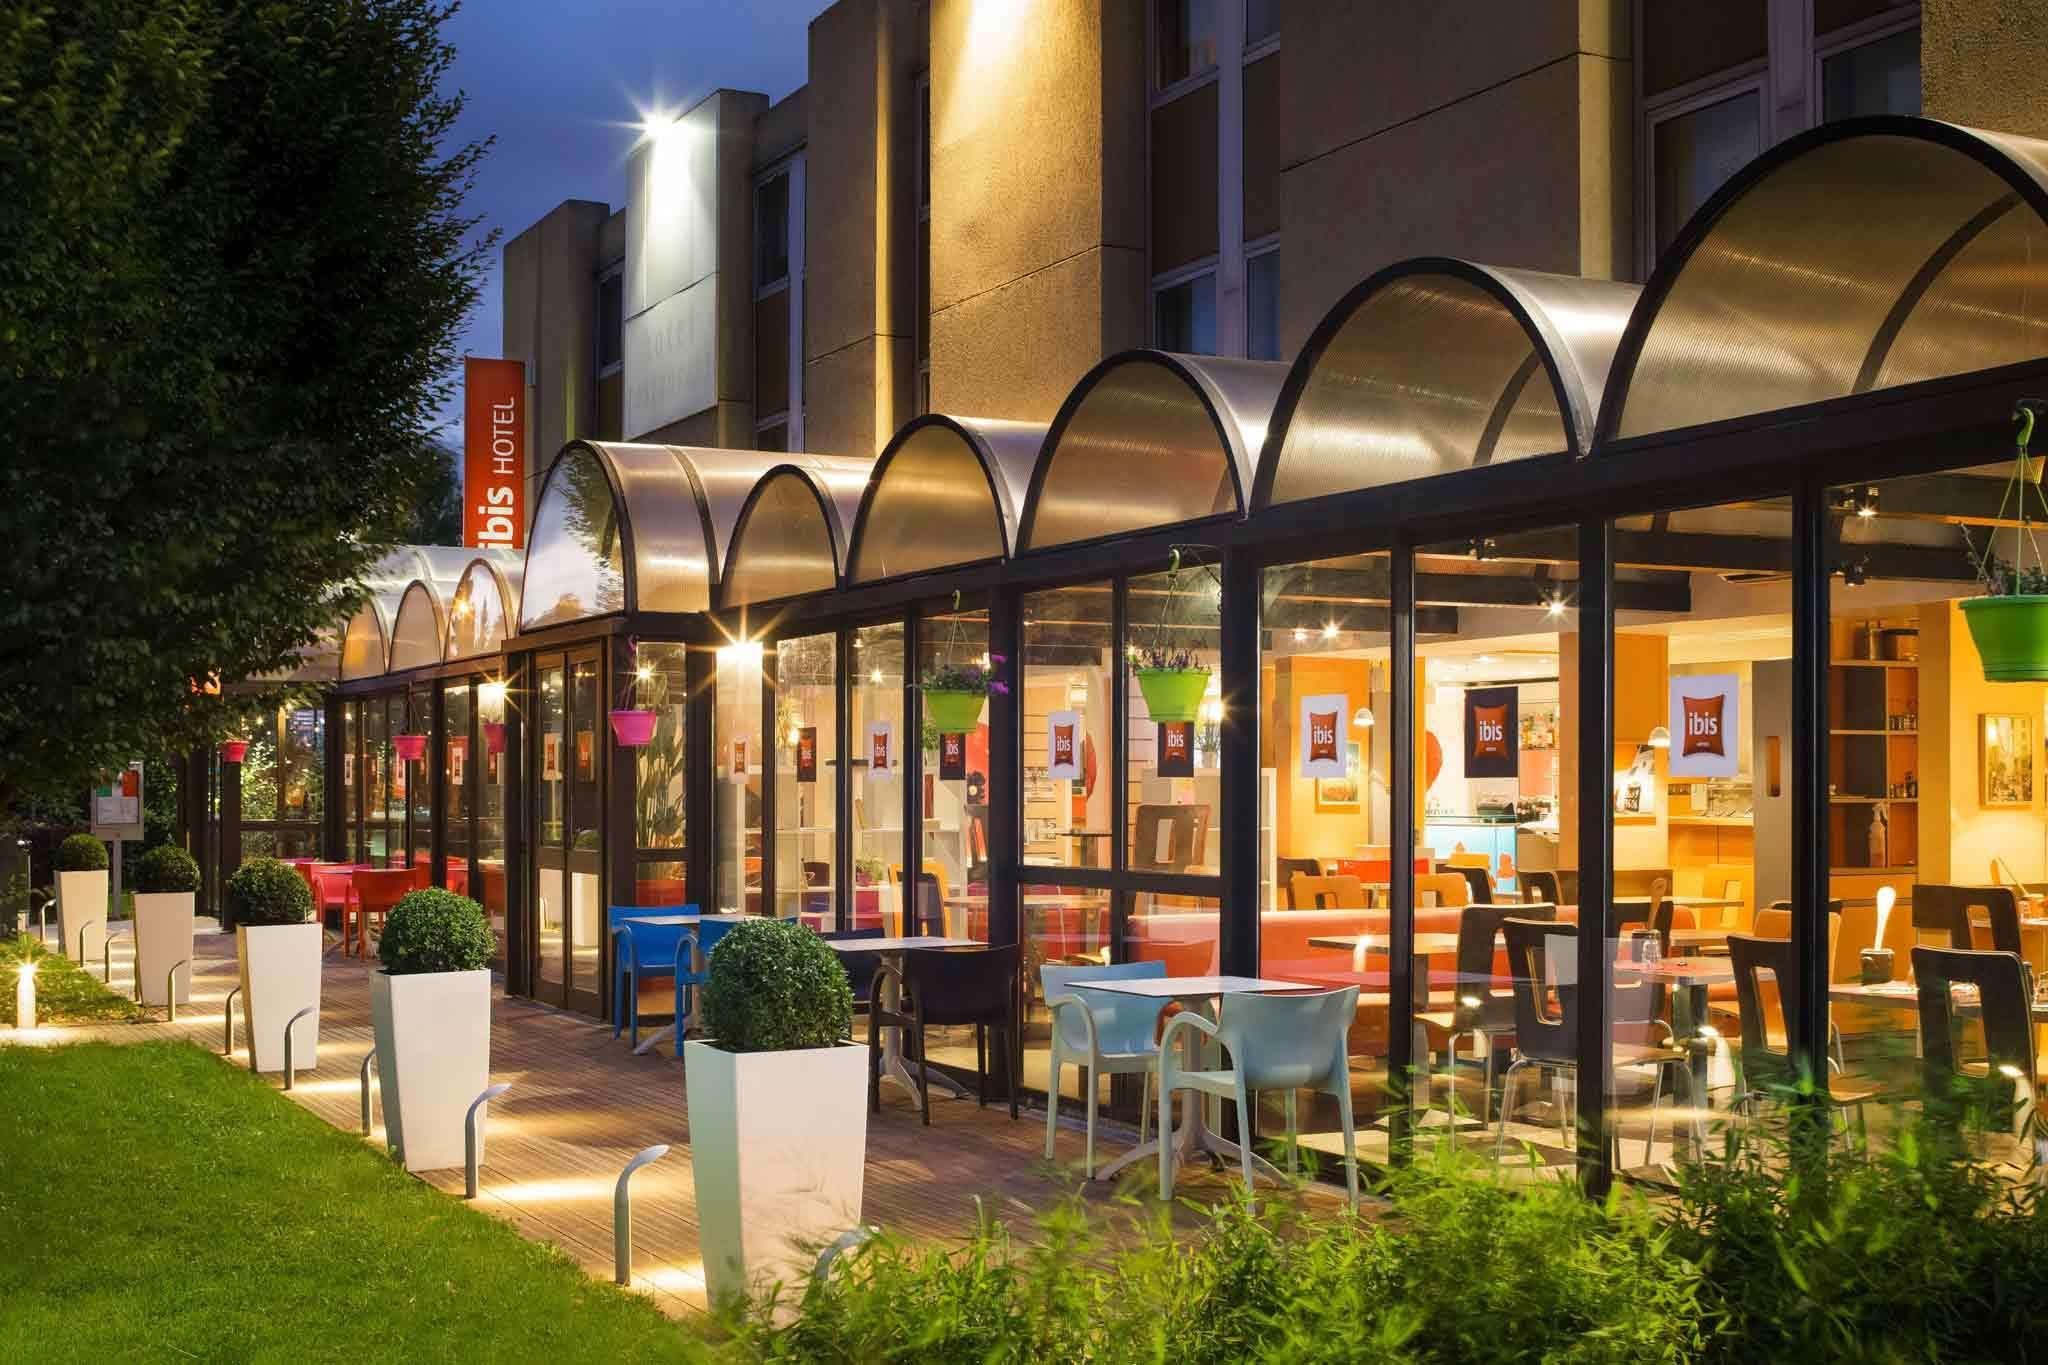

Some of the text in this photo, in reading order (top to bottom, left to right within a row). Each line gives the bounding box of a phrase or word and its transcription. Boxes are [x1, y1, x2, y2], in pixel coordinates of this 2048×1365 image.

[477, 396, 515, 549] ibis HOTEL
[1313, 723, 1334, 745] ibis
[1479, 719, 1503, 742] ibis
[1688, 711, 1718, 736] ibis
[1056, 735, 1072, 752] ibis
[1167, 730, 1185, 748] ibis
